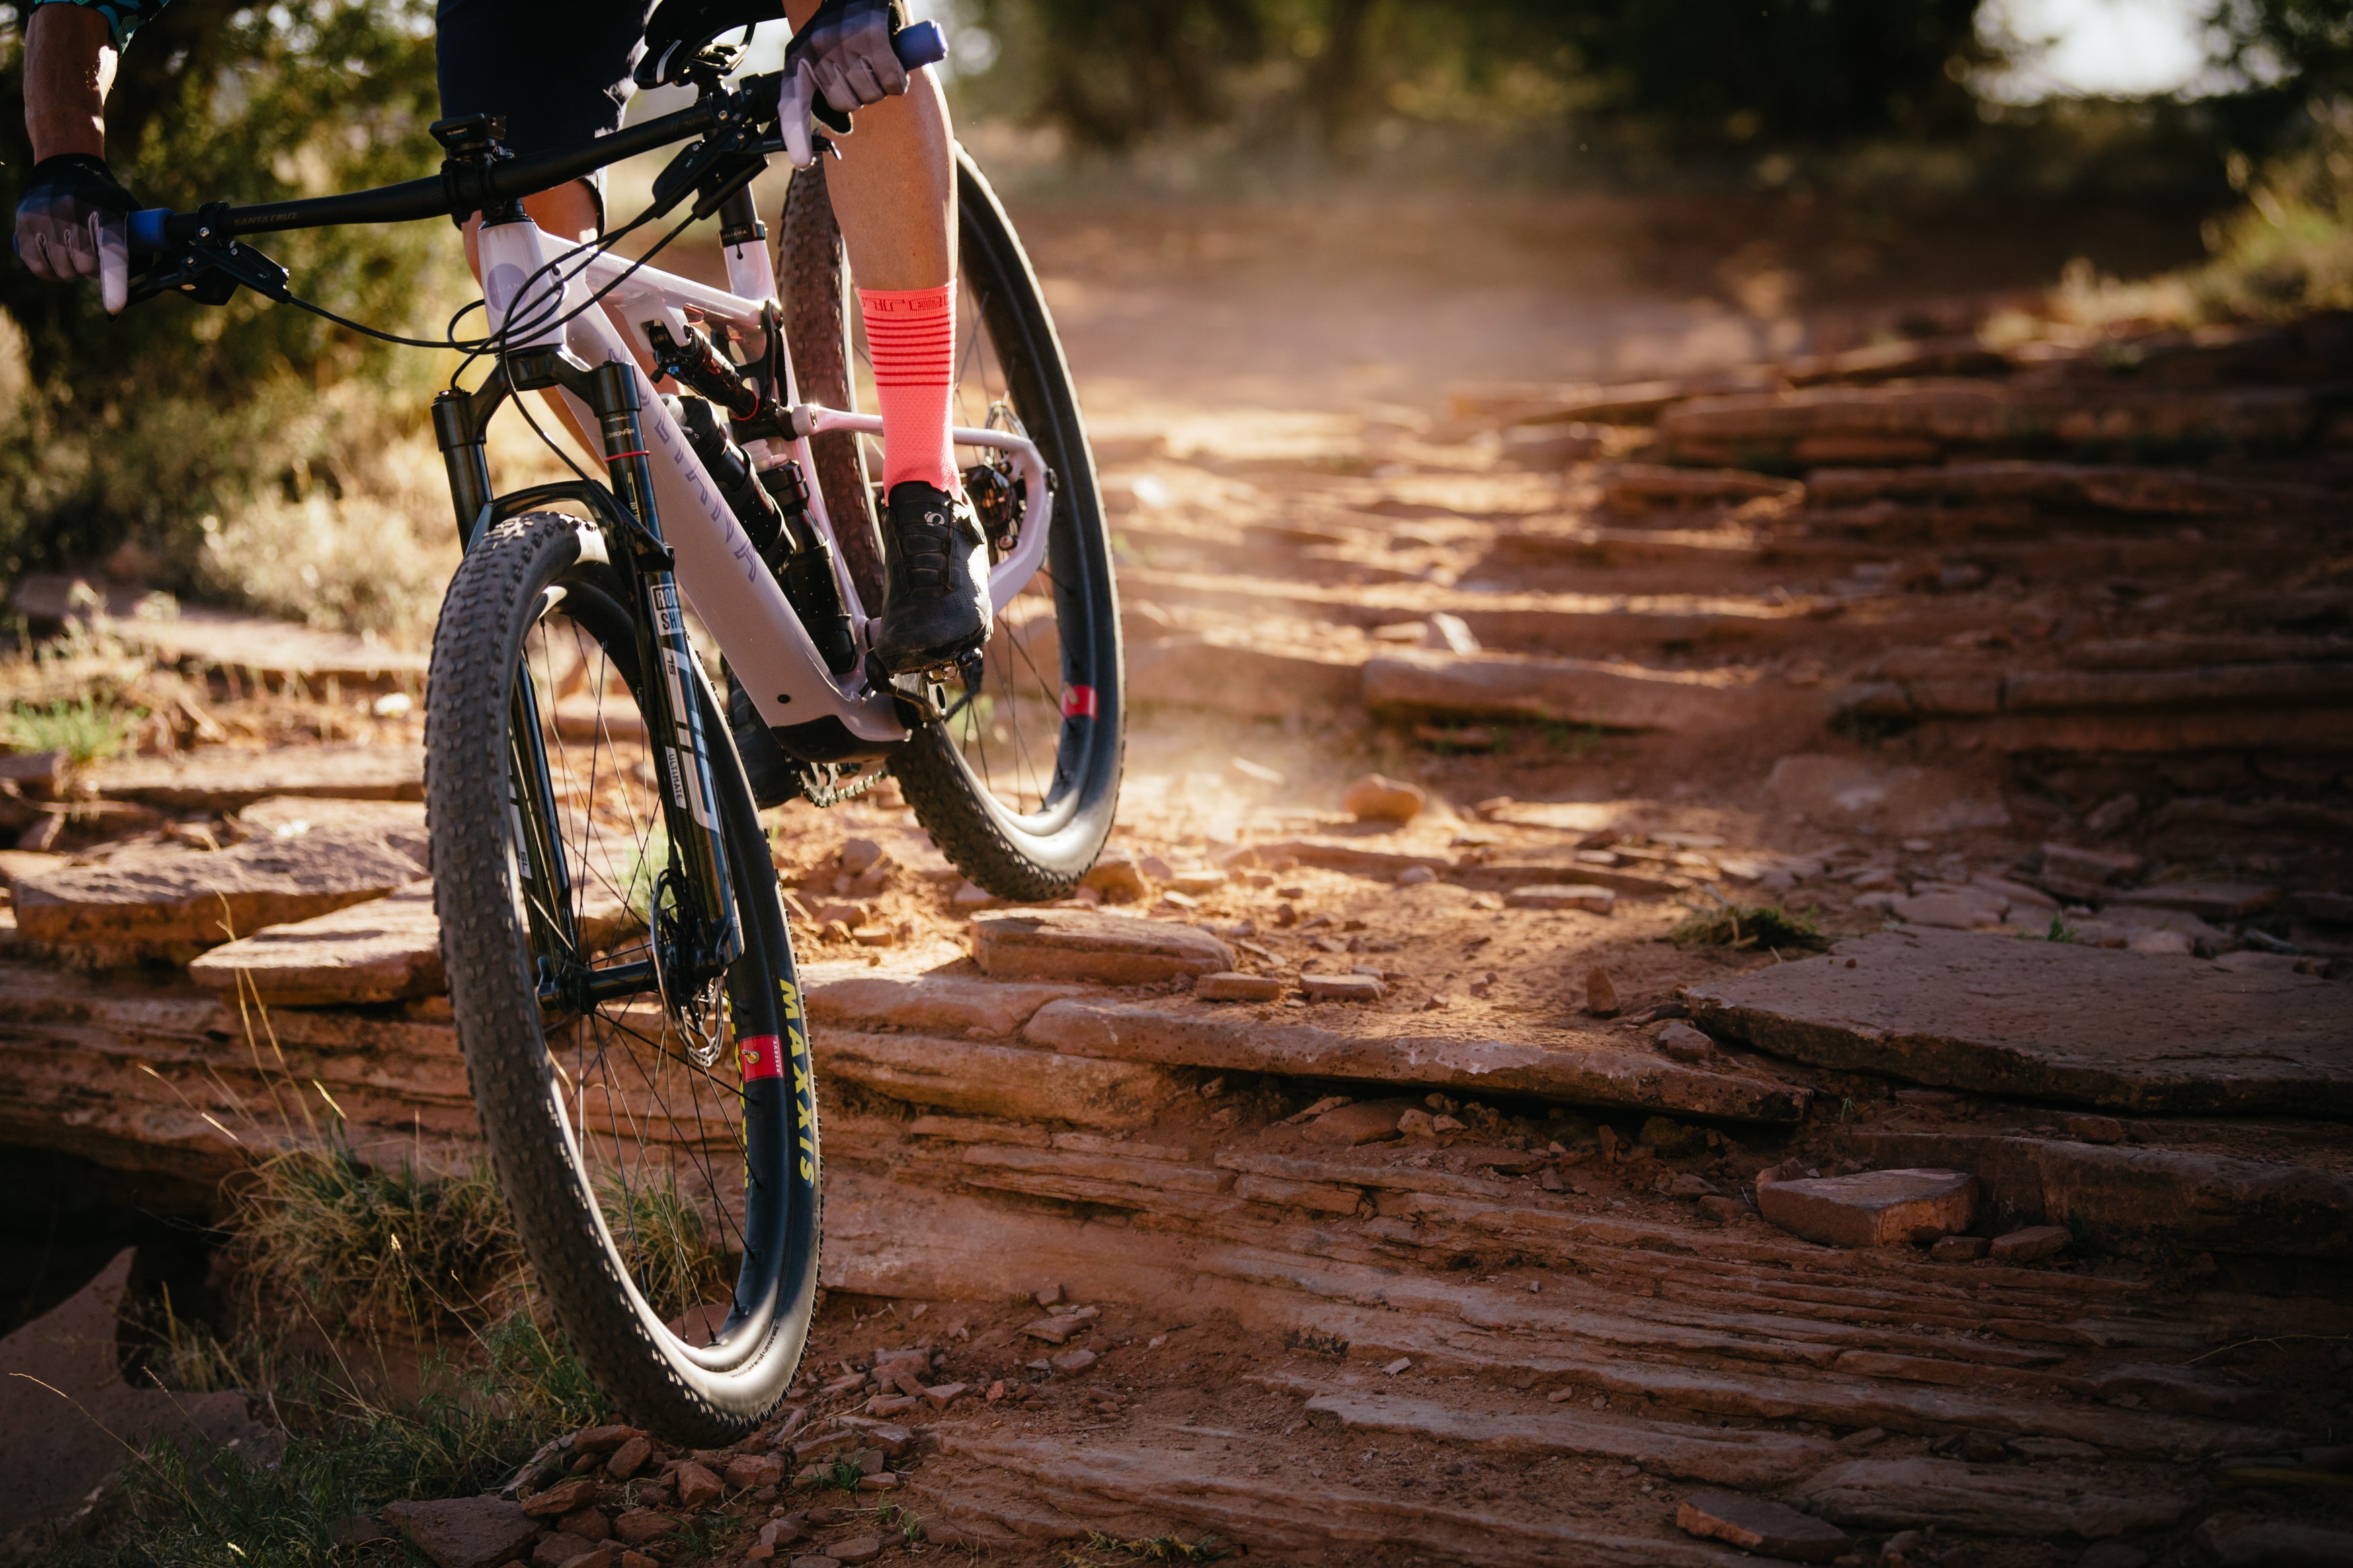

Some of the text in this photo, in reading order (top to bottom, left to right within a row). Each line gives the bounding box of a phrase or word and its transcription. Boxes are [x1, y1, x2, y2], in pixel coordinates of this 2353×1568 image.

[233, 212, 297, 226] SANTA CRUZ
[668, 753, 683, 800] ULTIMATE
[772, 1040, 781, 1073] RESERVE
[779, 978, 815, 1189] MAXXIS
